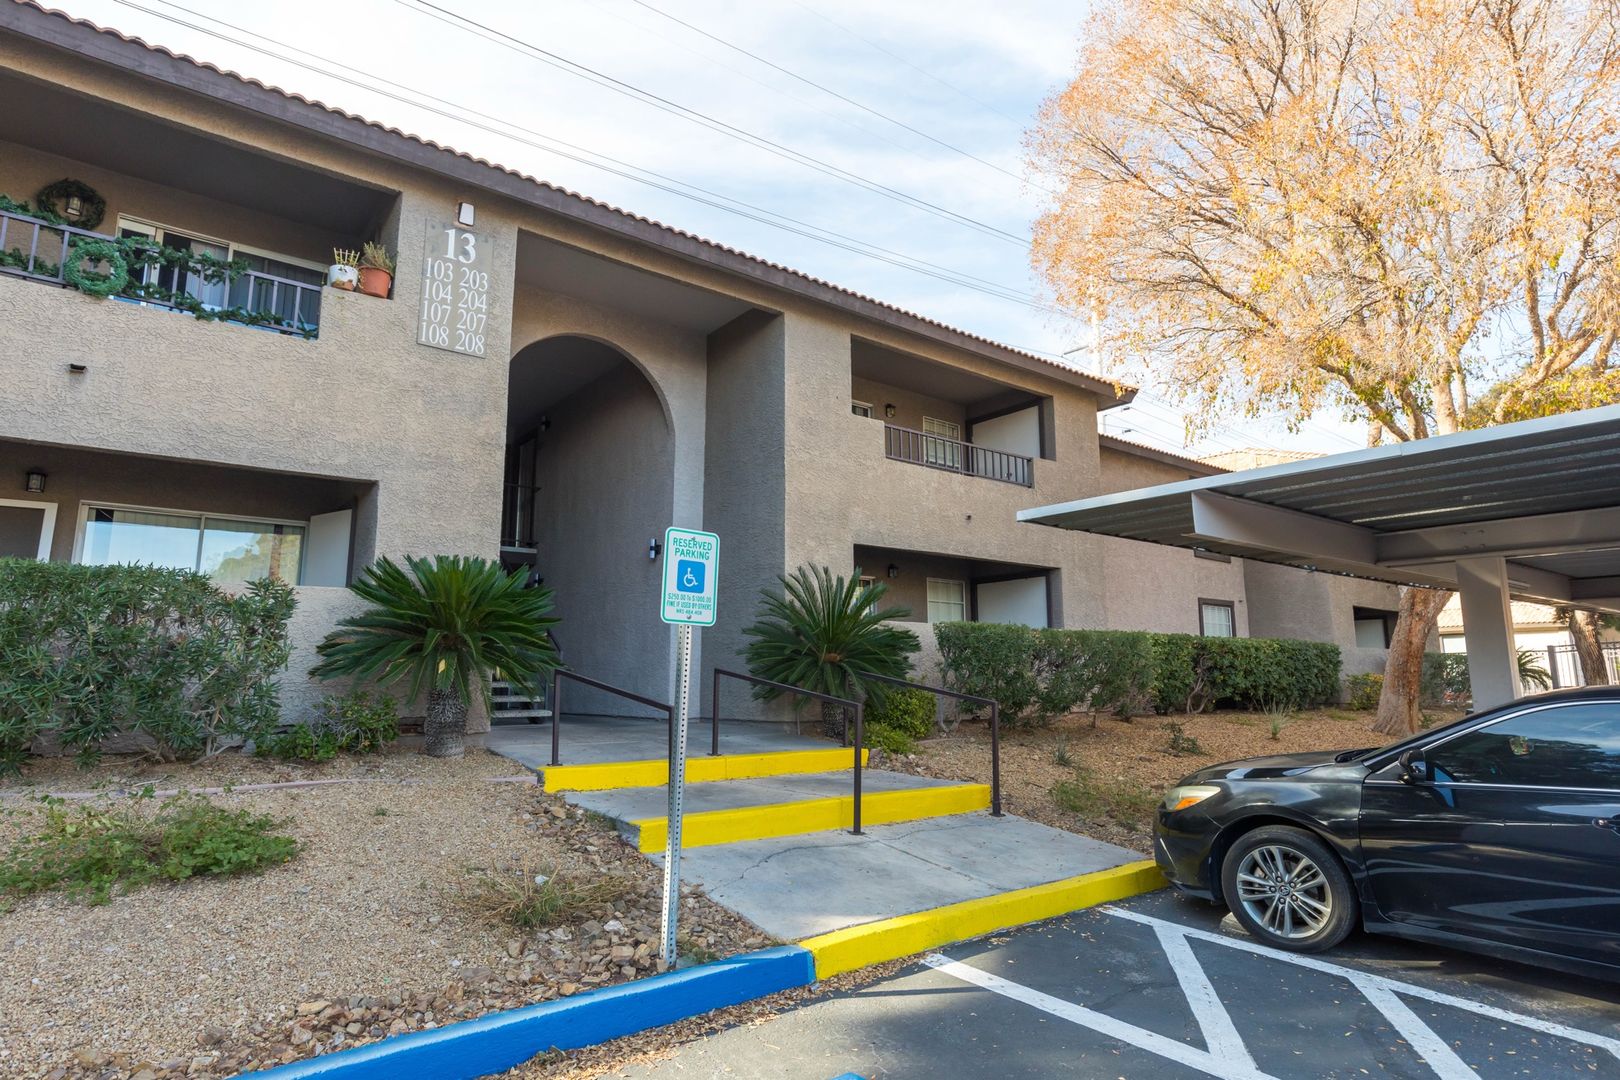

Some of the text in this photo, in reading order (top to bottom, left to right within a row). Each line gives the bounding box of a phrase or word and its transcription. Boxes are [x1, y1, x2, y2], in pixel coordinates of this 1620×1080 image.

[443, 228, 476, 264] 13
[426, 257, 488, 292] 103 203
[424, 279, 487, 312] 104 204
[422, 300, 486, 333] 107 207
[421, 322, 485, 355] 108 208
[672, 537, 712, 551] RESERVED
[674, 547, 710, 560] PARKING
